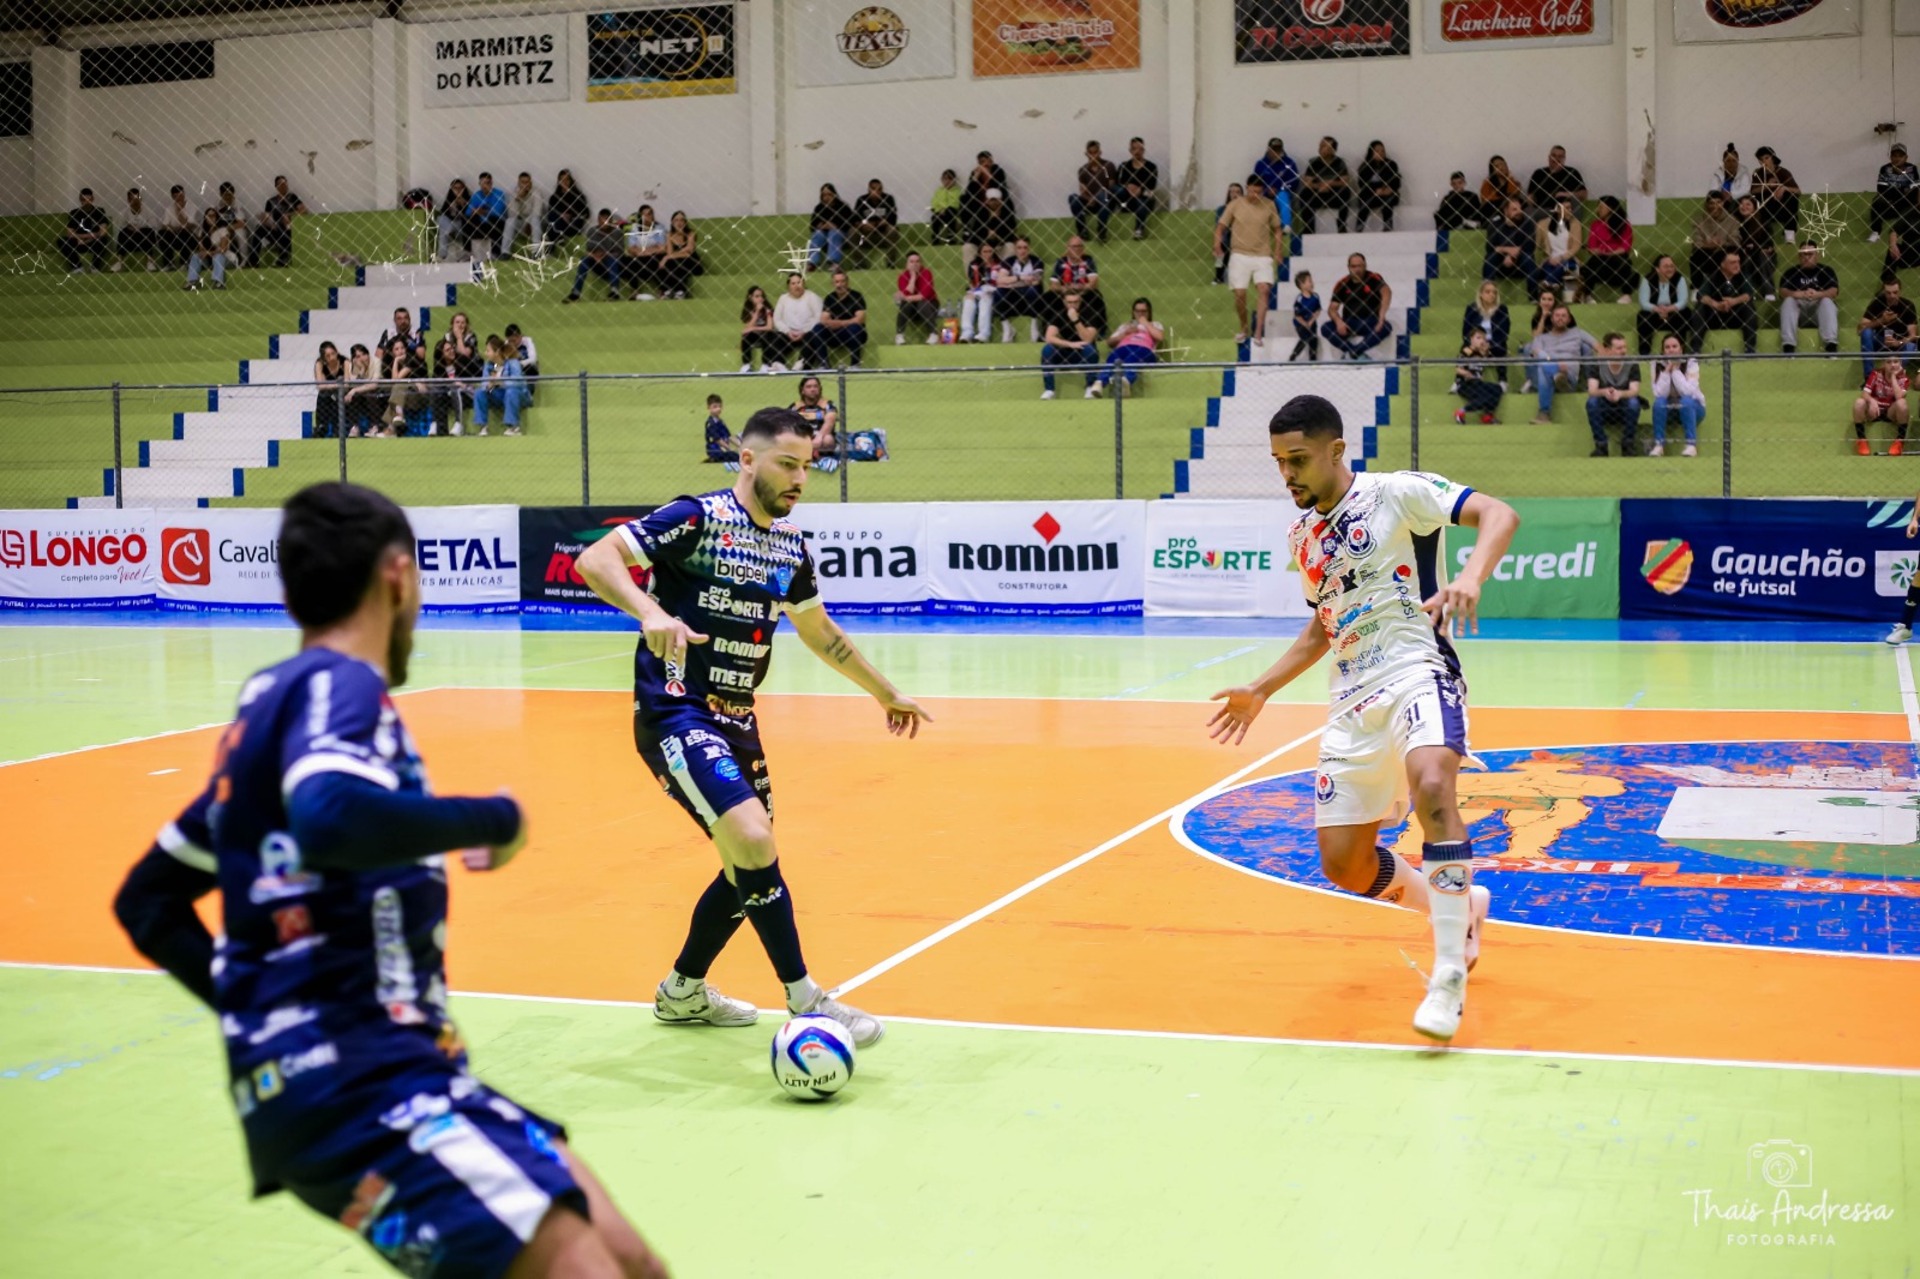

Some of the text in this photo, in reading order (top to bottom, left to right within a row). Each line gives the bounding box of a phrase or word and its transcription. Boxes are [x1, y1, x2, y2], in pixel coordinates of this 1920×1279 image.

[436, 34, 554, 60] MARMITAS
[840, 29, 905, 51] TEXAS
[437, 60, 554, 90] DO KURTZ
[29, 529, 148, 567] LONGO
[818, 531, 884, 541] GRUPO
[218, 538, 279, 564] Caval
[417, 537, 518, 572] ETAL
[1153, 549, 1272, 571] ESPORTE
[1454, 541, 1598, 581] Scredi
[1710, 545, 1866, 578] Gauchão
[998, 582, 1069, 591] CONSTRUTORA
[1713, 577, 1797, 598] de futsal
[697, 591, 765, 620] ESPORTE
